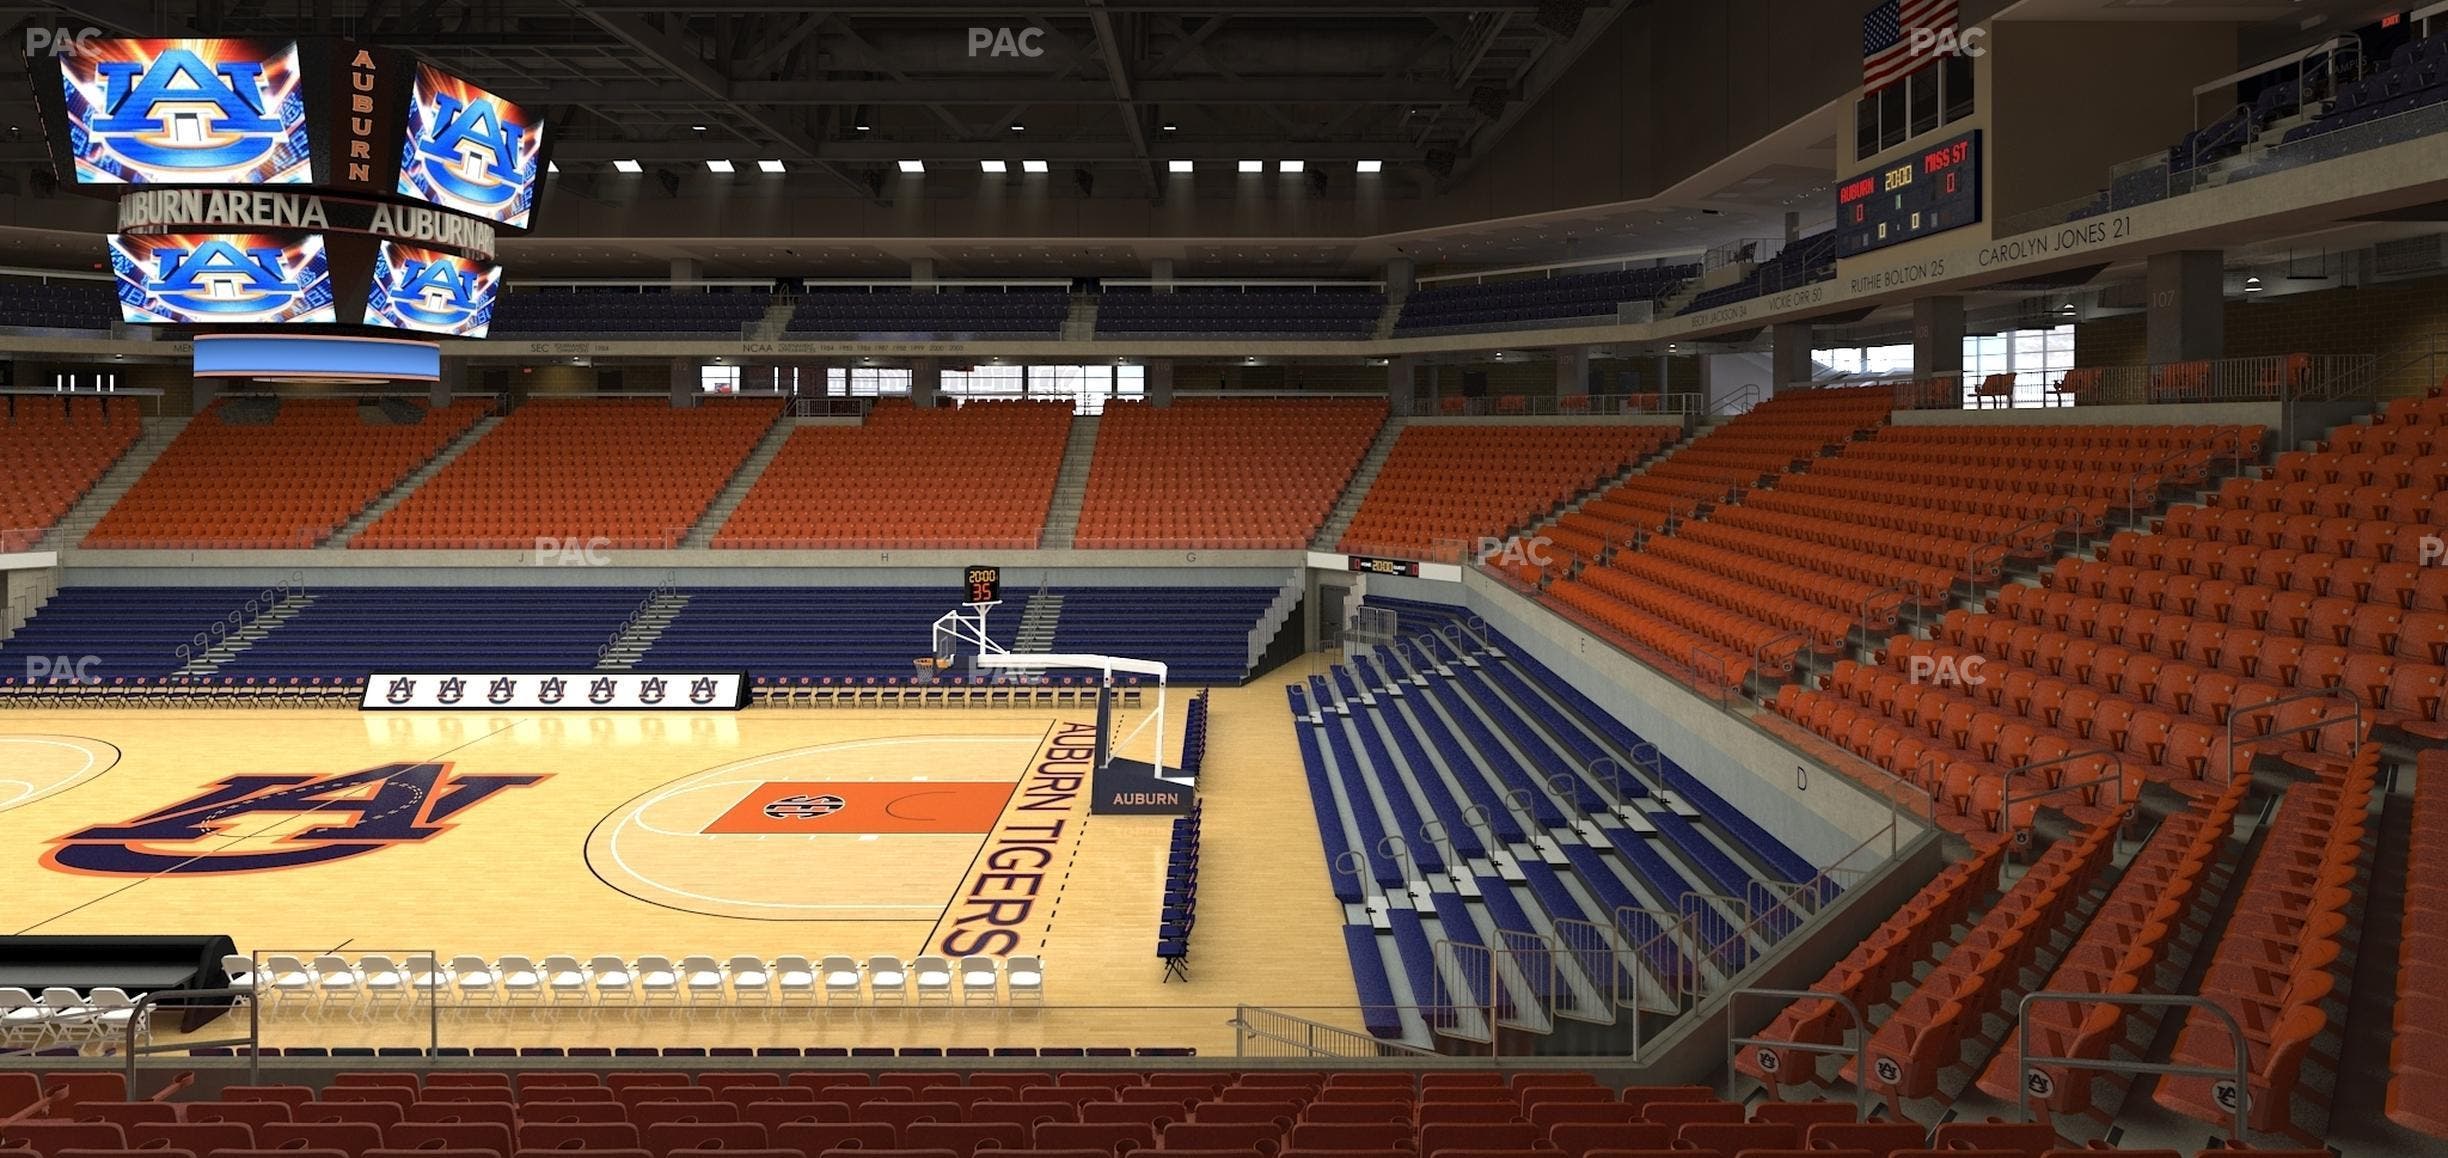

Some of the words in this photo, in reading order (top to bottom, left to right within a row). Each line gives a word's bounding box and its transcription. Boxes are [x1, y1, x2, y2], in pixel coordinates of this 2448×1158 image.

[348, 49, 376, 182] AUBURN
[1924, 148, 1950, 174] MISS
[1952, 140, 1969, 163] ST
[1884, 163, 1913, 193] 20:00
[1840, 176, 1875, 205] AUBURN
[118, 189, 206, 229] AUBURN
[206, 189, 330, 230] ARENA
[368, 202, 475, 248] AUBURN
[1978, 235, 2048, 267] CAROLYN
[2054, 221, 2106, 252] JONES
[2112, 216, 2131, 239] 21
[1851, 274, 1882, 294] RUTHIE
[1884, 264, 1928, 288] BOLTON
[1931, 259, 1945, 278] 25
[1793, 290, 1810, 307] ORR
[2152, 289, 2176, 309] 107
[530, 344, 549, 353] SEC
[742, 344, 774, 353] NCAA
[881, 553, 889, 562] H
[1186, 552, 1197, 562] G
[1372, 560, 1394, 573] 20:00
[969, 570, 996, 583] 20:00
[973, 583, 992, 601] 35
[1016, 720, 1098, 812] AUBURN
[1797, 766, 1808, 790] D
[1112, 792, 1179, 806] AUBURN
[940, 818, 1067, 957] TIGERS
